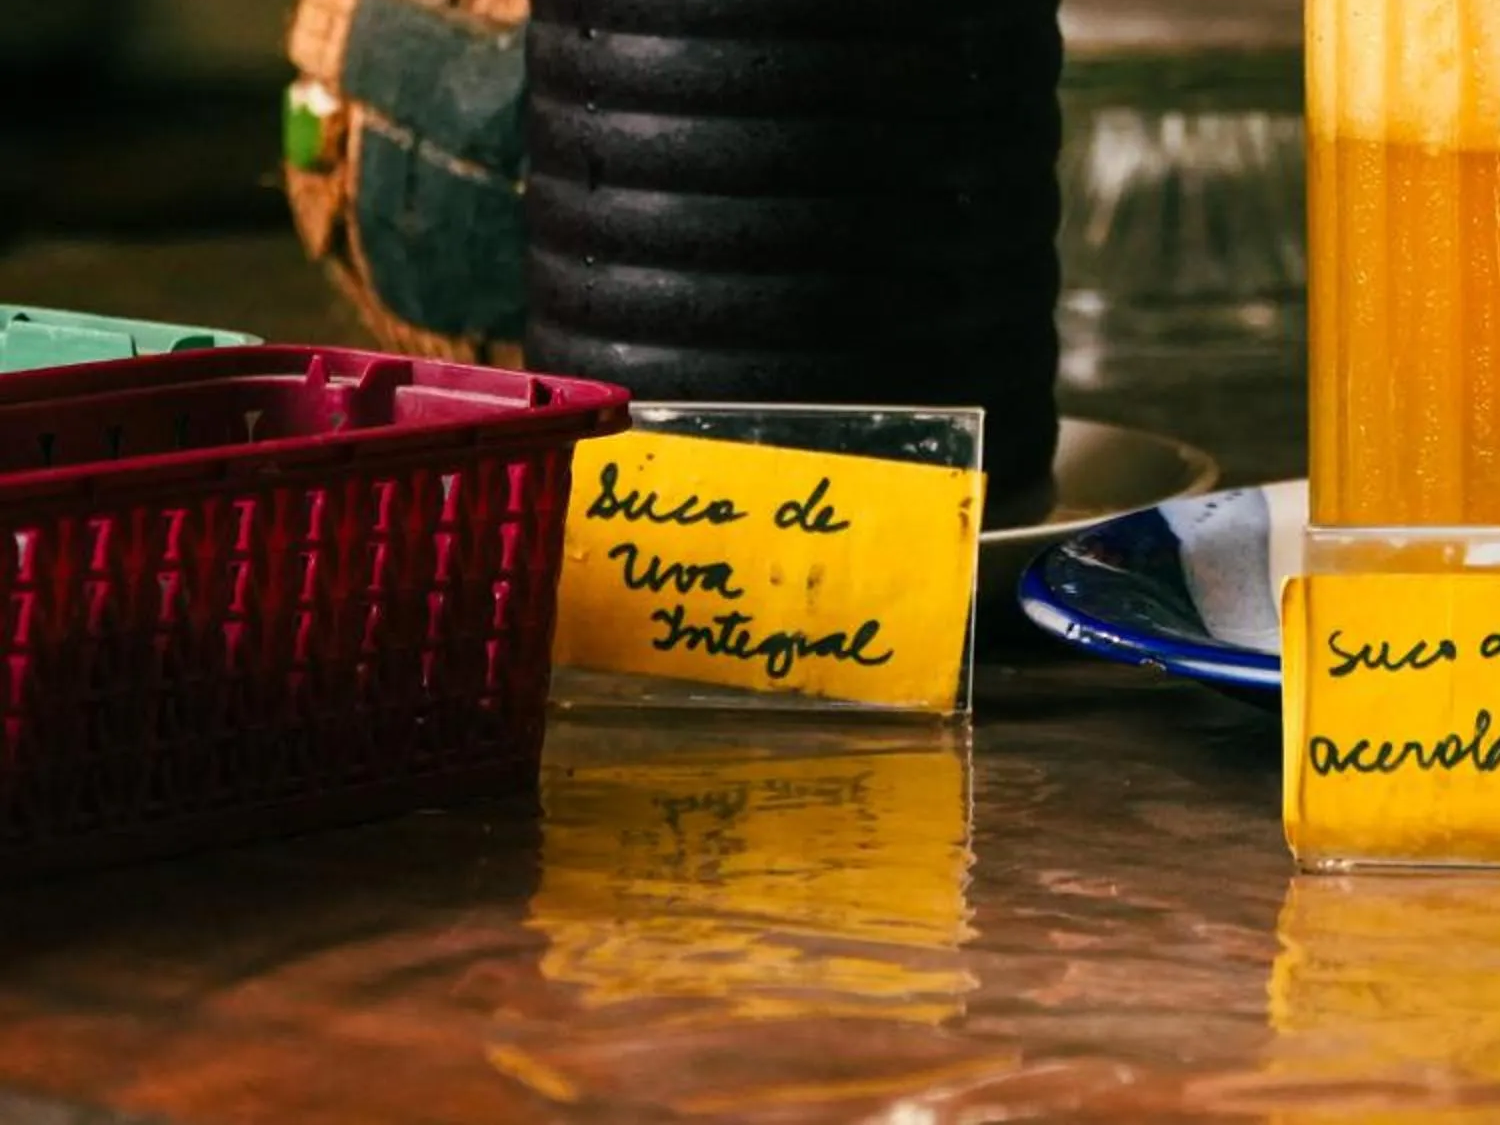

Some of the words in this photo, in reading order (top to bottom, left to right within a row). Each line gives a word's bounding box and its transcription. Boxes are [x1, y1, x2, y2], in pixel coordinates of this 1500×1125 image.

[587, 462, 748, 524] Suco
[774, 478, 850, 533] de
[608, 542, 744, 600] Uva
[650, 603, 895, 678] Integral
